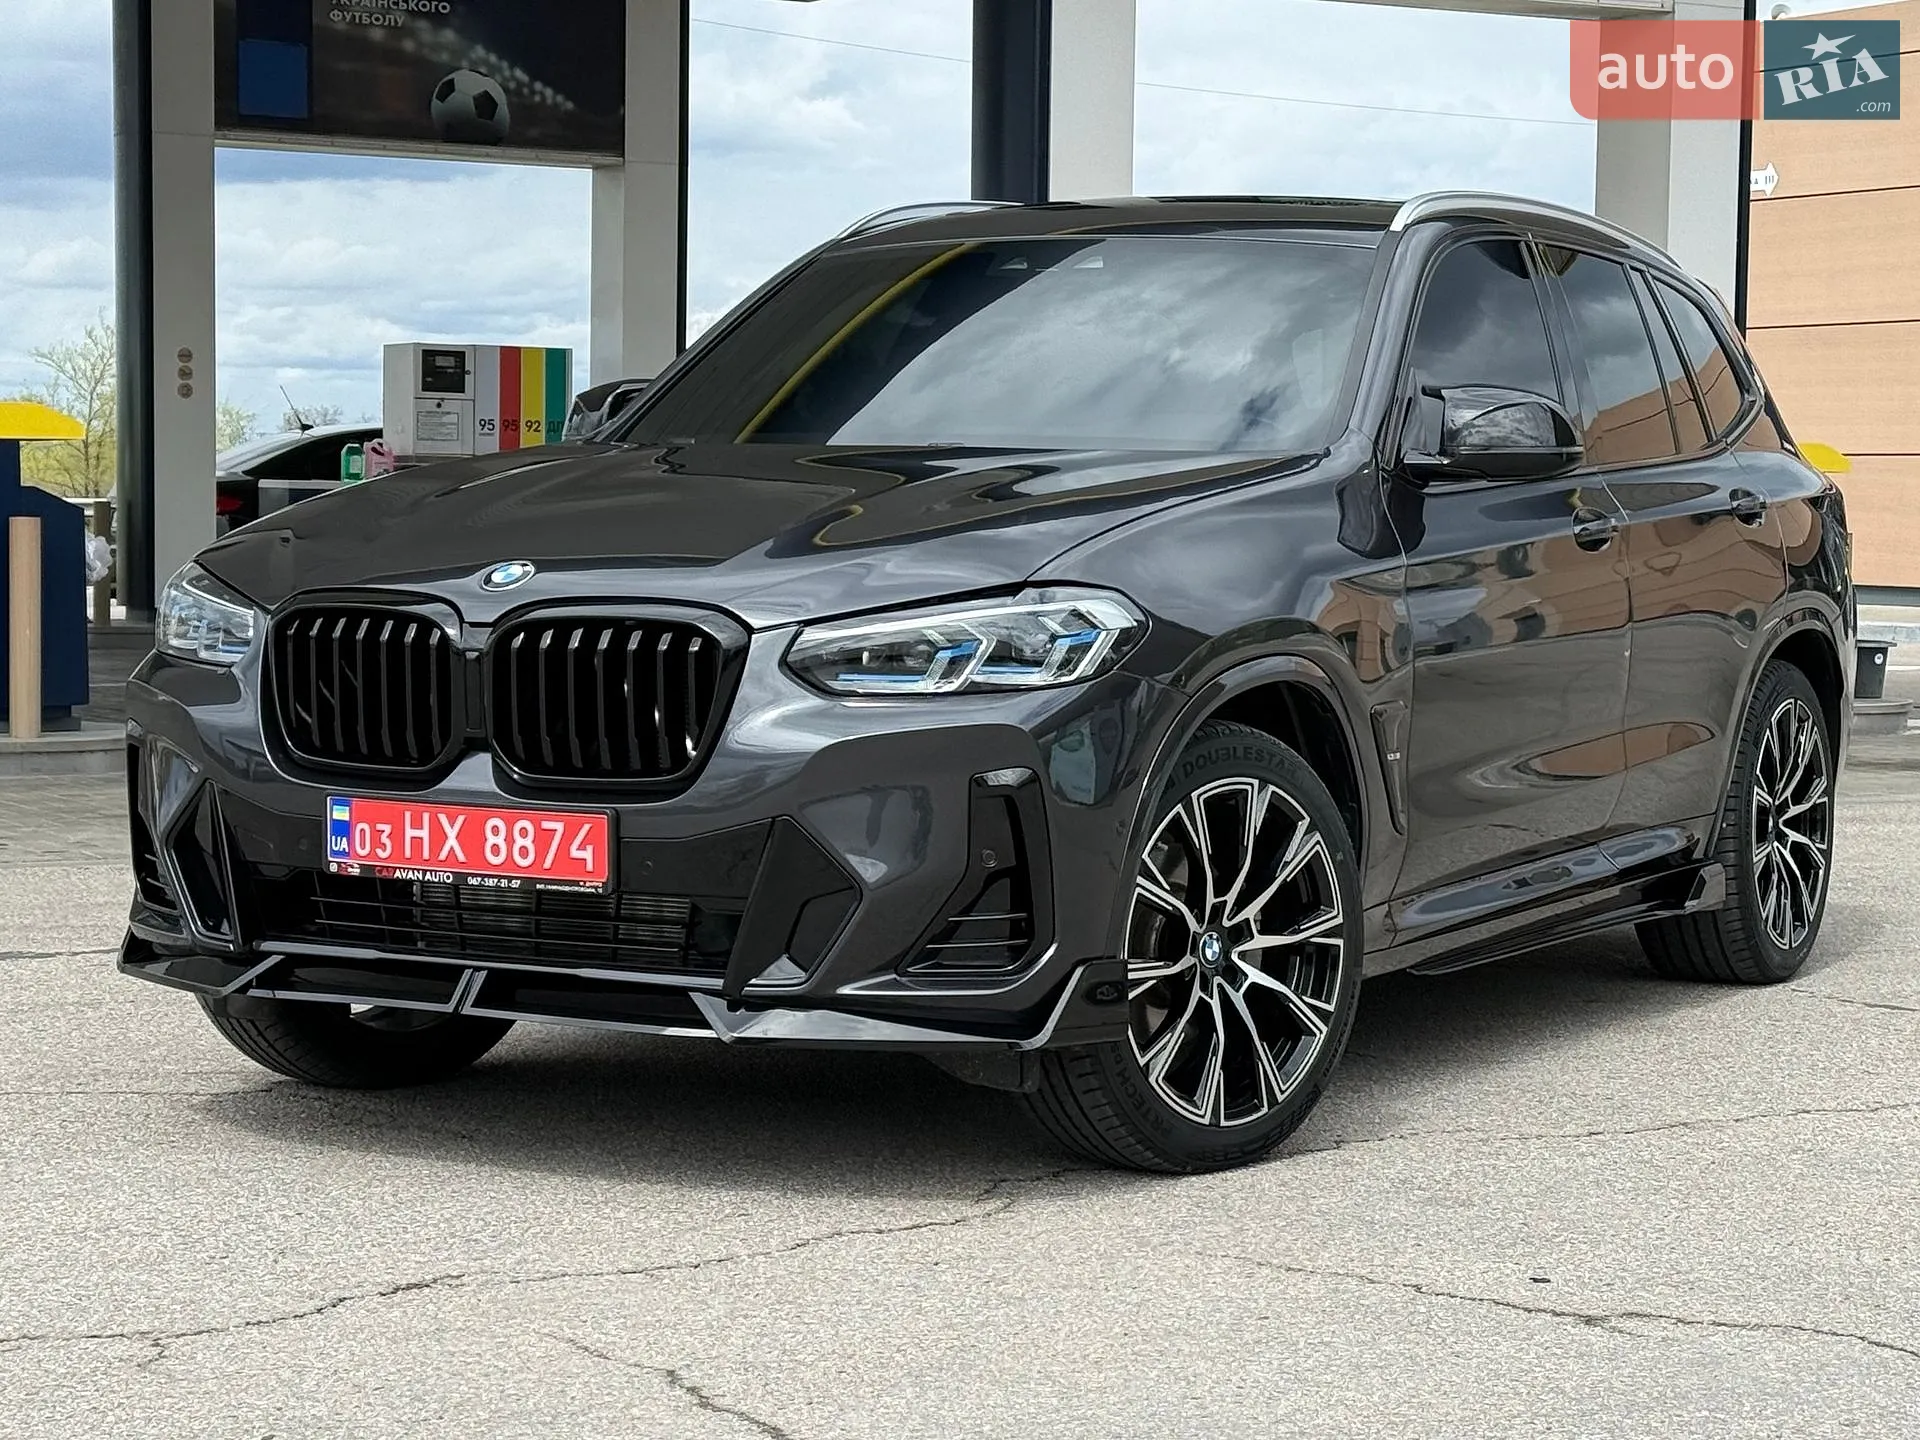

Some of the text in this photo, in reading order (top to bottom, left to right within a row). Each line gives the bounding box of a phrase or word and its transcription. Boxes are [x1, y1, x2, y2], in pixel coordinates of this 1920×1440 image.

[329, 9, 405, 28] ФУТБОЛУ
[479, 418, 496, 432] 95
[502, 419, 519, 432] 95
[525, 419, 542, 433] 92
[331, 836, 349, 853] UA
[354, 811, 596, 873] 03 HX 8874
[375, 867, 422, 881] CARAVAN
[424, 870, 453, 883] AUTO
